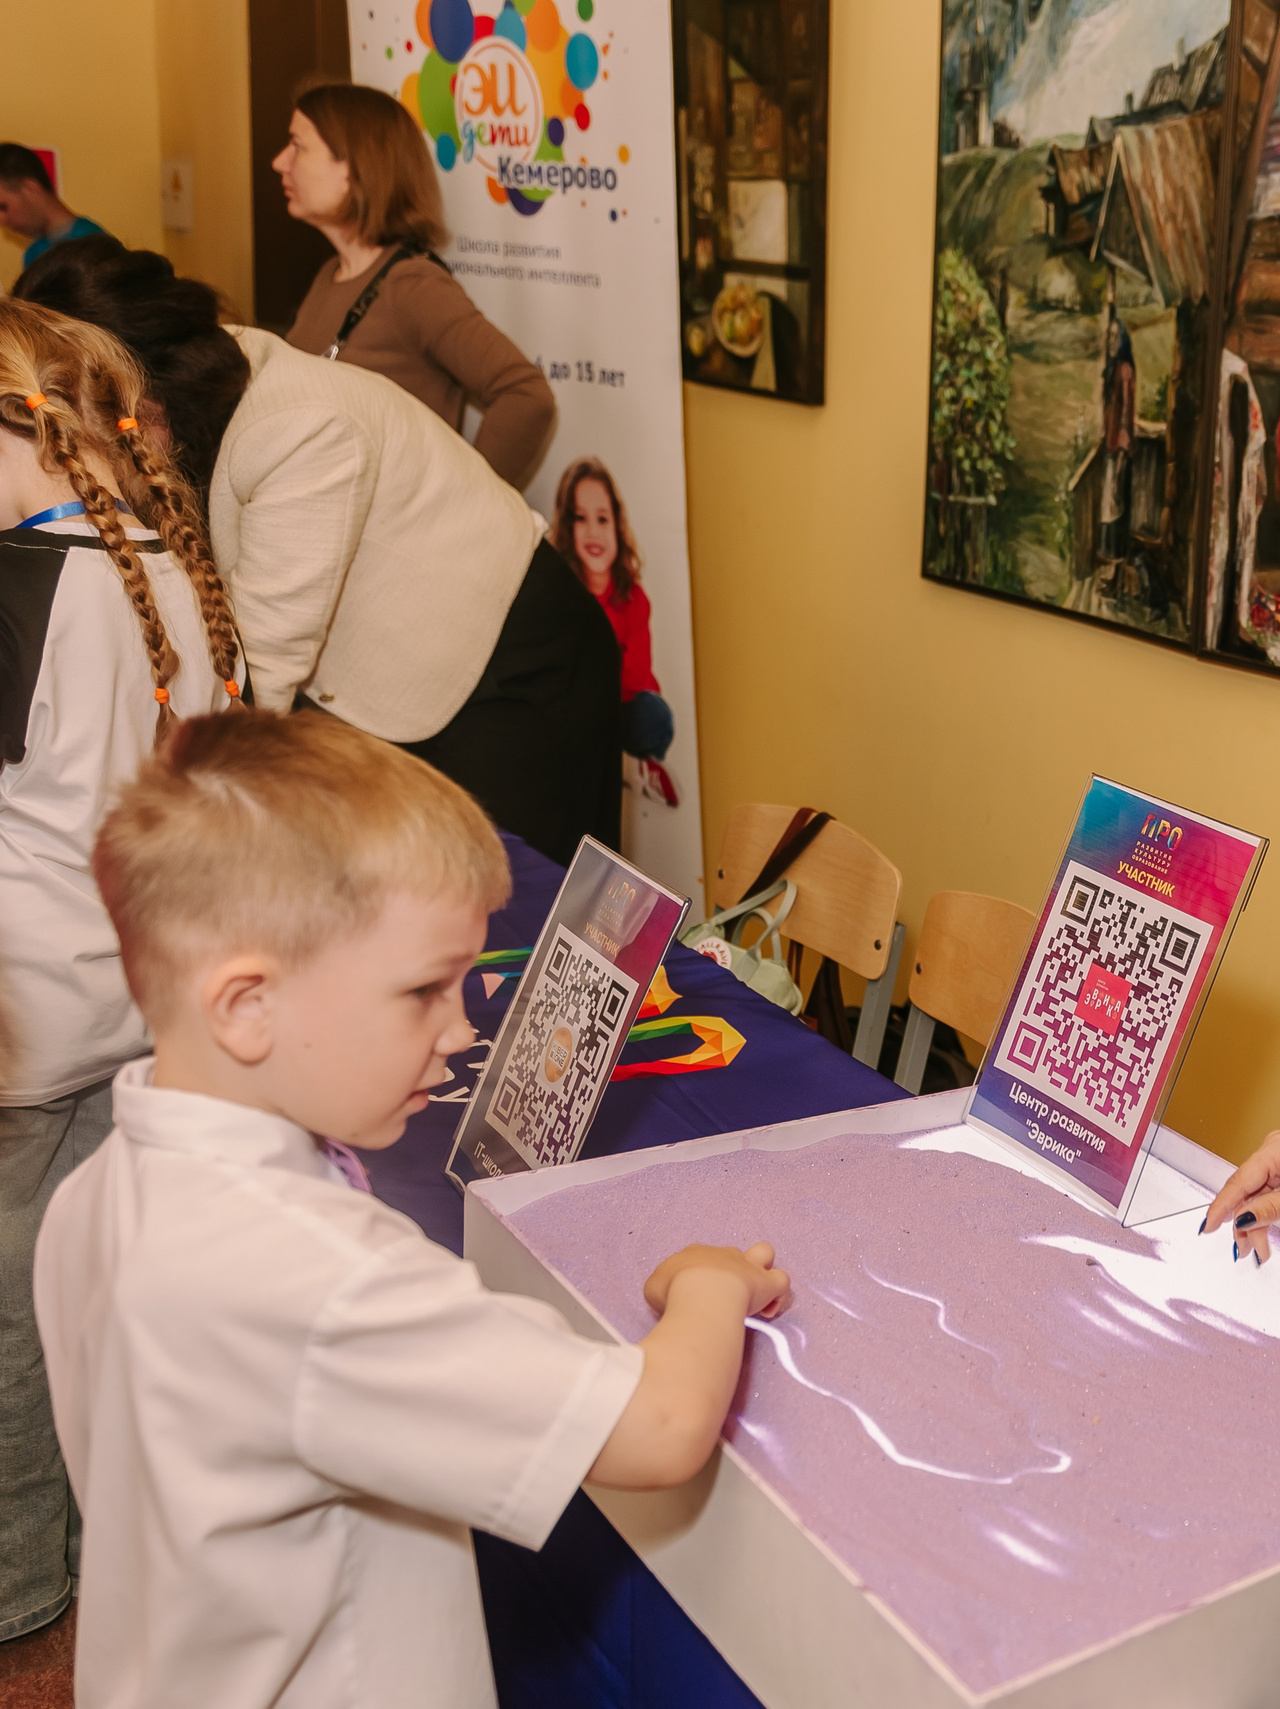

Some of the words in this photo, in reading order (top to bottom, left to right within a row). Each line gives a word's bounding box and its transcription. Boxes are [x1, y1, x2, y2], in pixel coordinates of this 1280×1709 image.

[461, 121, 531, 163] дети
[498, 156, 617, 194] Кемерово
[456, 235, 500, 256] Школа
[502, 241, 561, 260] развития
[550, 360, 571, 381] до
[576, 358, 595, 383] 15
[598, 367, 626, 388] лет
[1141, 813, 1183, 851] ПРО
[1117, 860, 1175, 898] УЧАСТНИК
[584, 921, 620, 957] УЧАСТНИК
[1008, 1081, 1049, 1118] Центр
[1048, 1109, 1106, 1154] развития
[474, 1141, 505, 1177] IT-школ
[1025, 1118, 1082, 1164] "Эврика"
